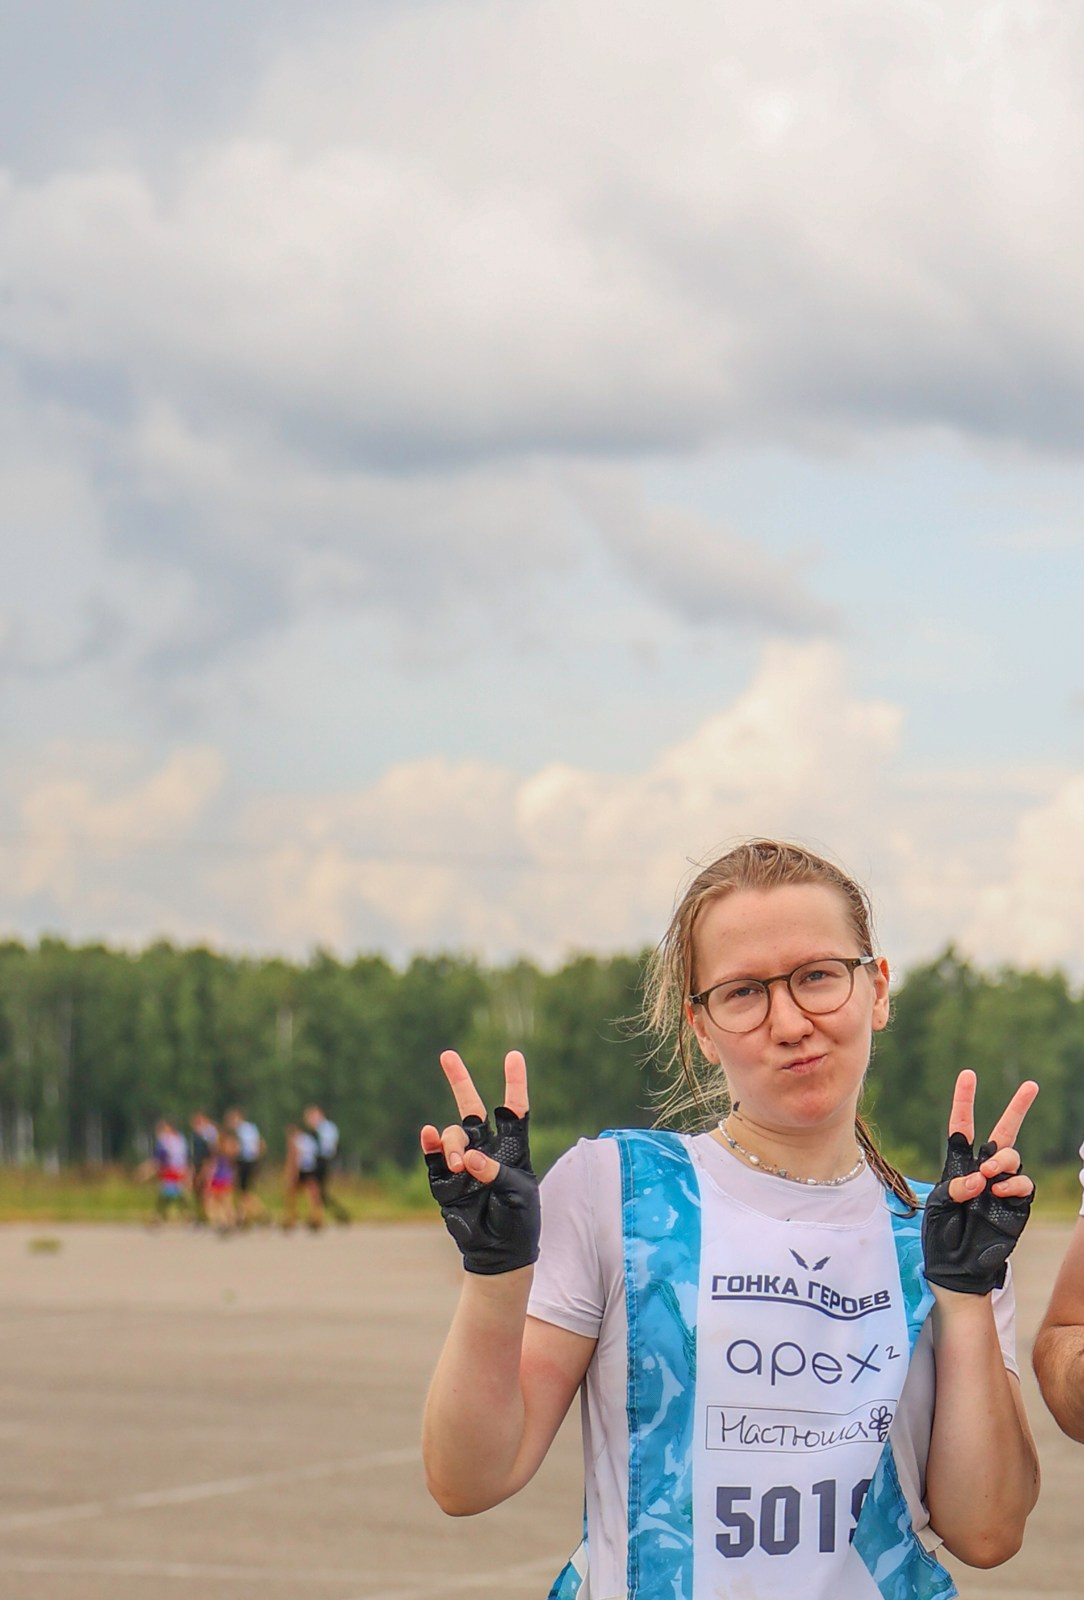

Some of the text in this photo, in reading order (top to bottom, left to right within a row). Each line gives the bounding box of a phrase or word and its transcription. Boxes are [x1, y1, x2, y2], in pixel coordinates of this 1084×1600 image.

[711, 1274, 892, 1314] ГОНКА ГЕРОЕВ
[720, 1410, 869, 1448] Настюша
